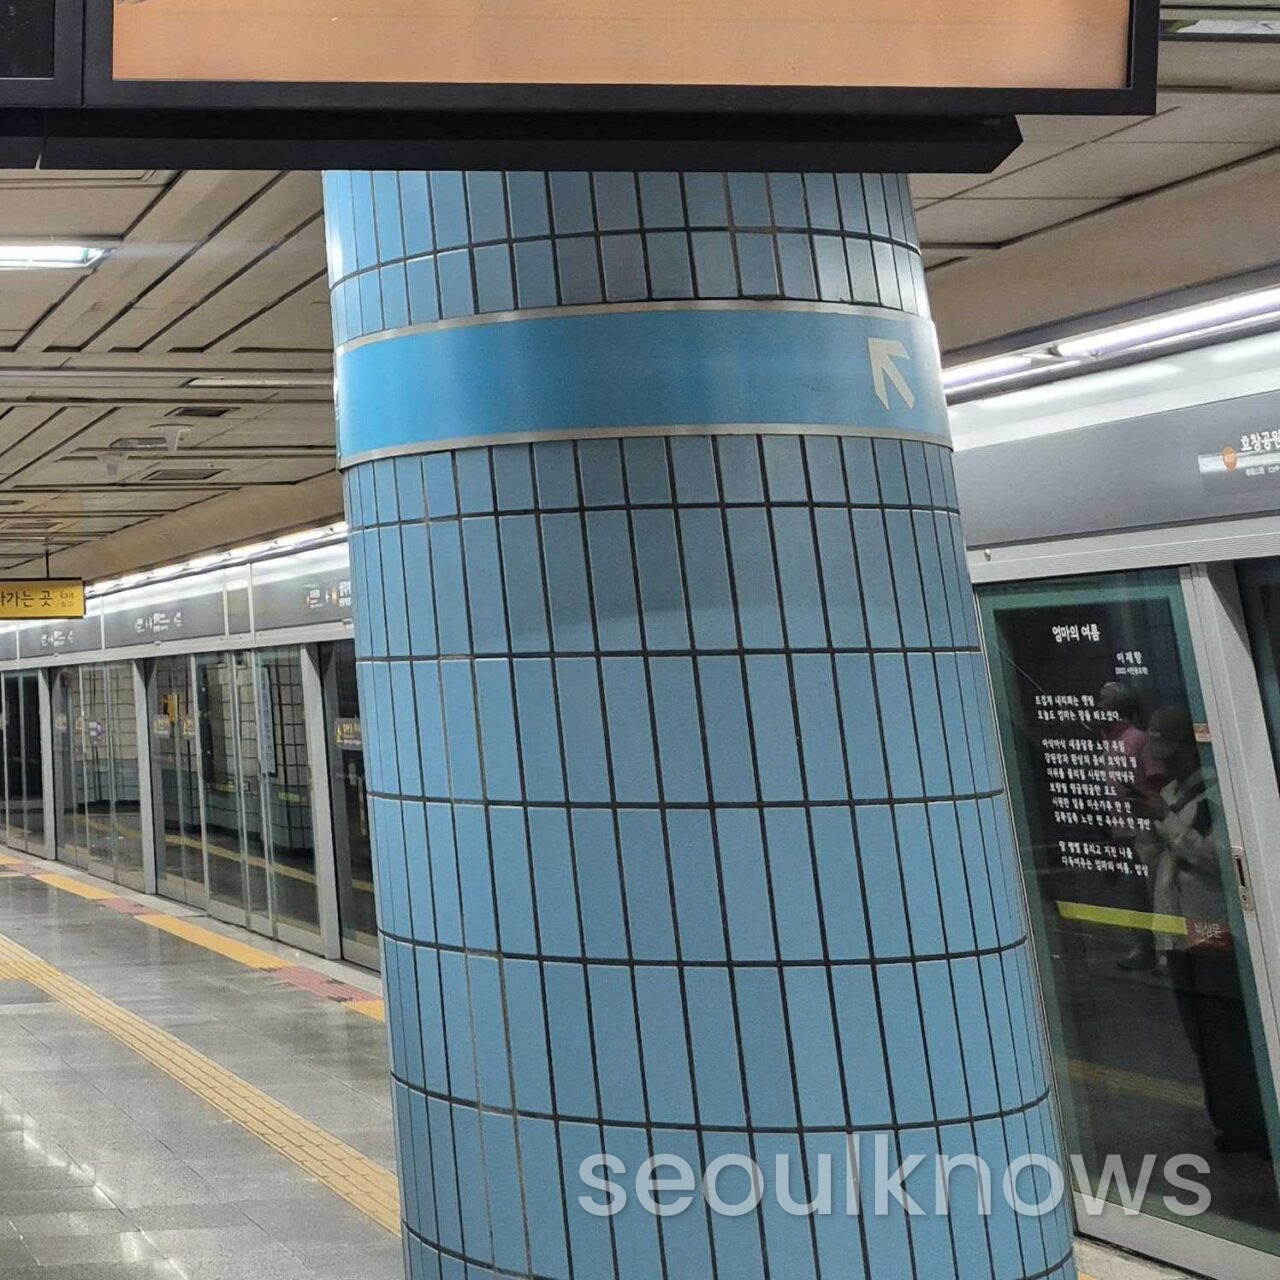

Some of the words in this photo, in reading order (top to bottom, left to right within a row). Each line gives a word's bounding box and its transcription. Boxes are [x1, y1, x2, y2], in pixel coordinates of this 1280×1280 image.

[39, 590, 53, 608] 곳
[1052, 624, 1079, 643] 엄마의
[1081, 623, 1100, 642] 여름
[1037, 710, 1056, 721] 오늘도
[1057, 710, 1076, 722] 엄마는
